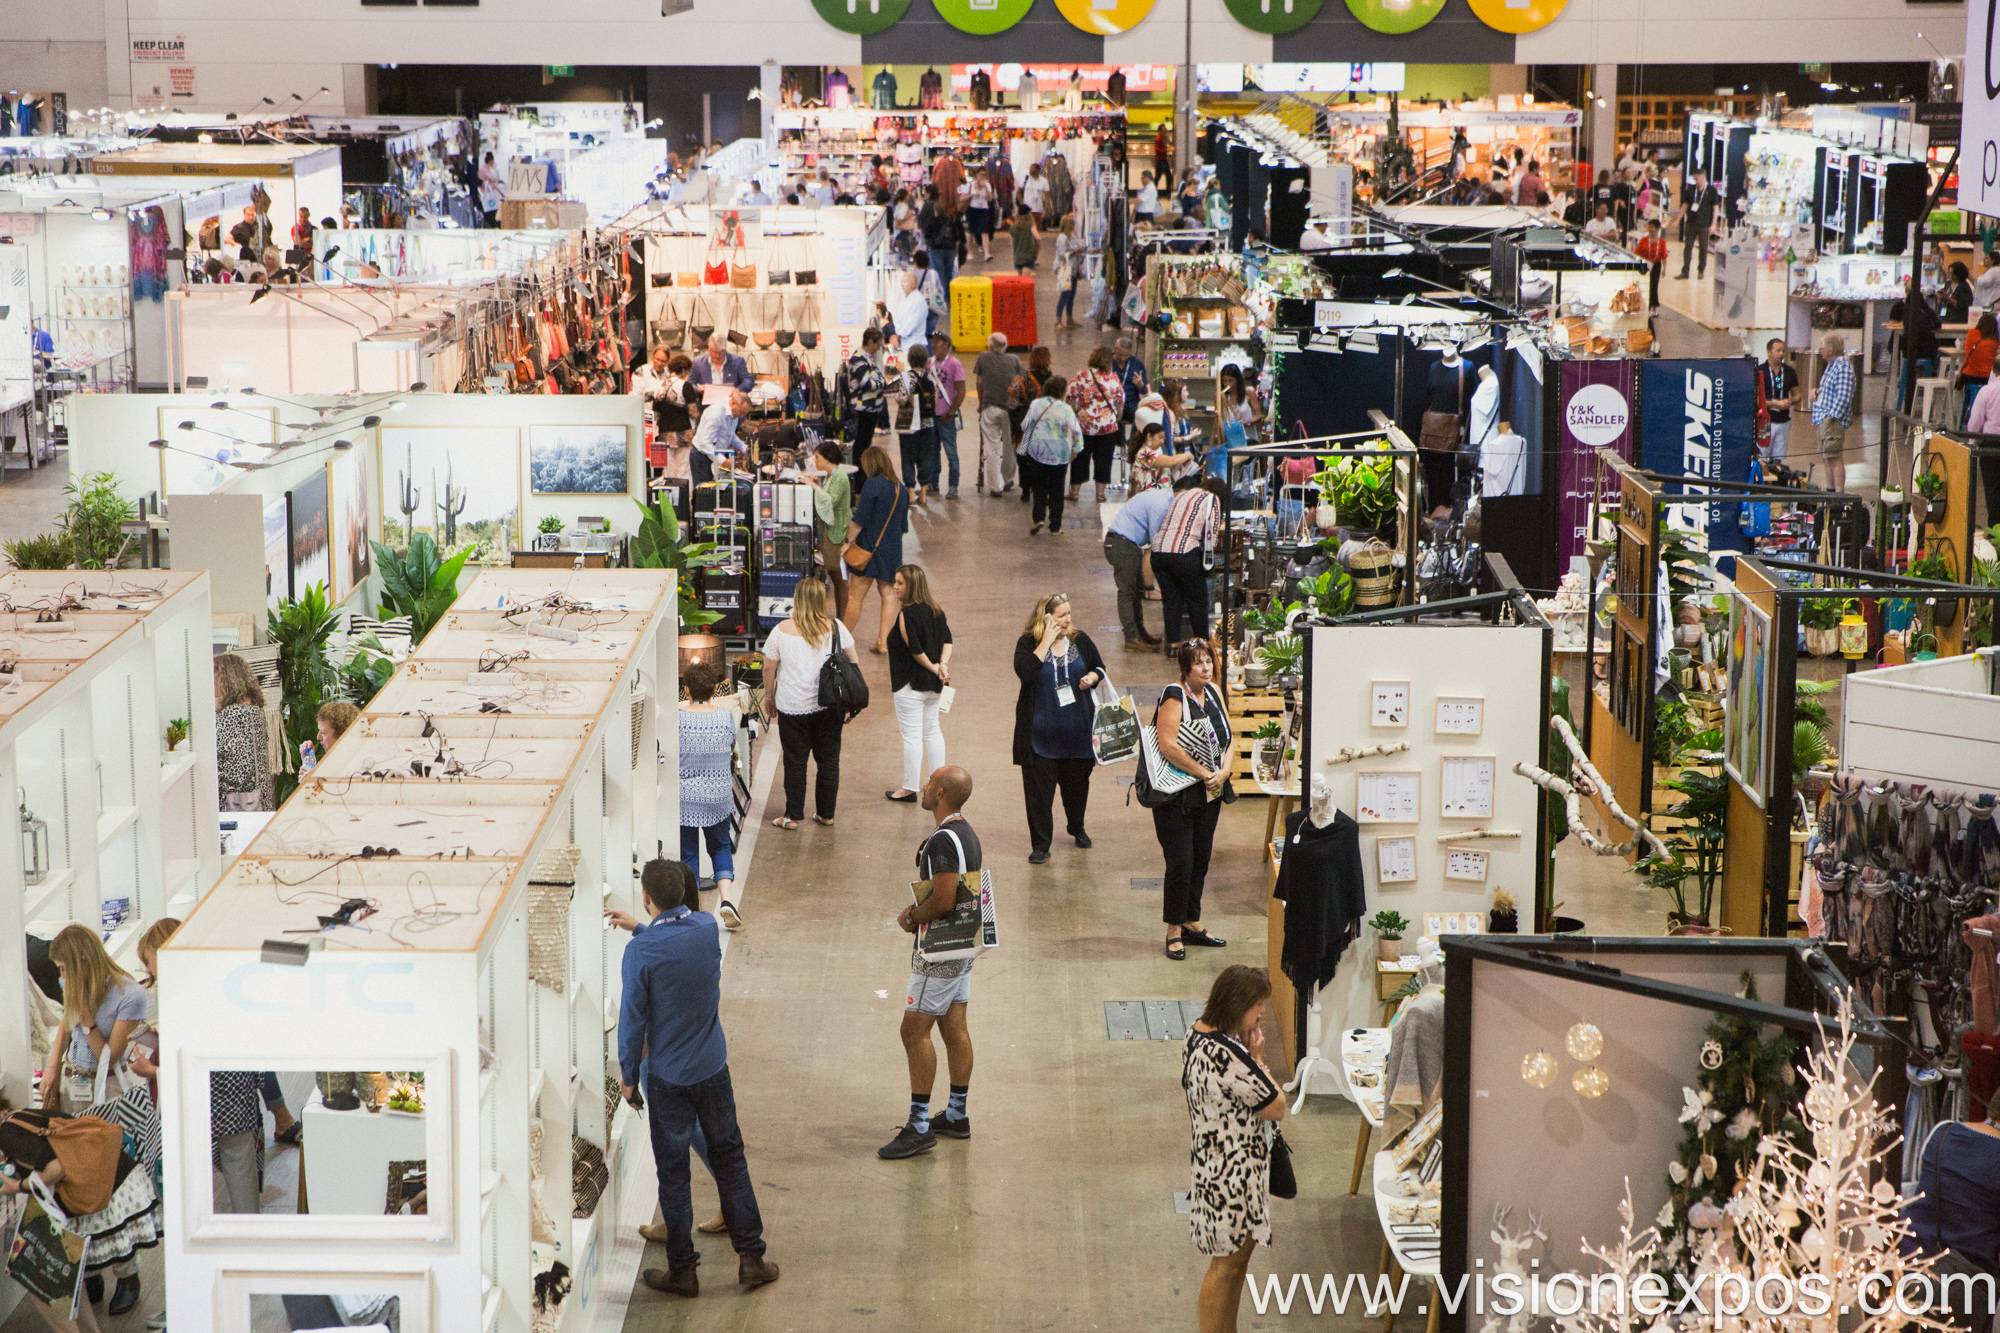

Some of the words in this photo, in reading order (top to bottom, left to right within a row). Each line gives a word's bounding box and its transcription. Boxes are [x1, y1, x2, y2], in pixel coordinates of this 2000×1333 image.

[133, 41, 156, 50] KEEP
[157, 41, 185, 50] CLEAR
[552, 66, 568, 75] EXIT
[1318, 310, 1342, 322] D119
[1714, 378, 1724, 426] OFFICIAL
[1570, 405, 1595, 415] Y&K
[1570, 416, 1625, 425] SANDLER
[1711, 509, 1721, 524] OF
